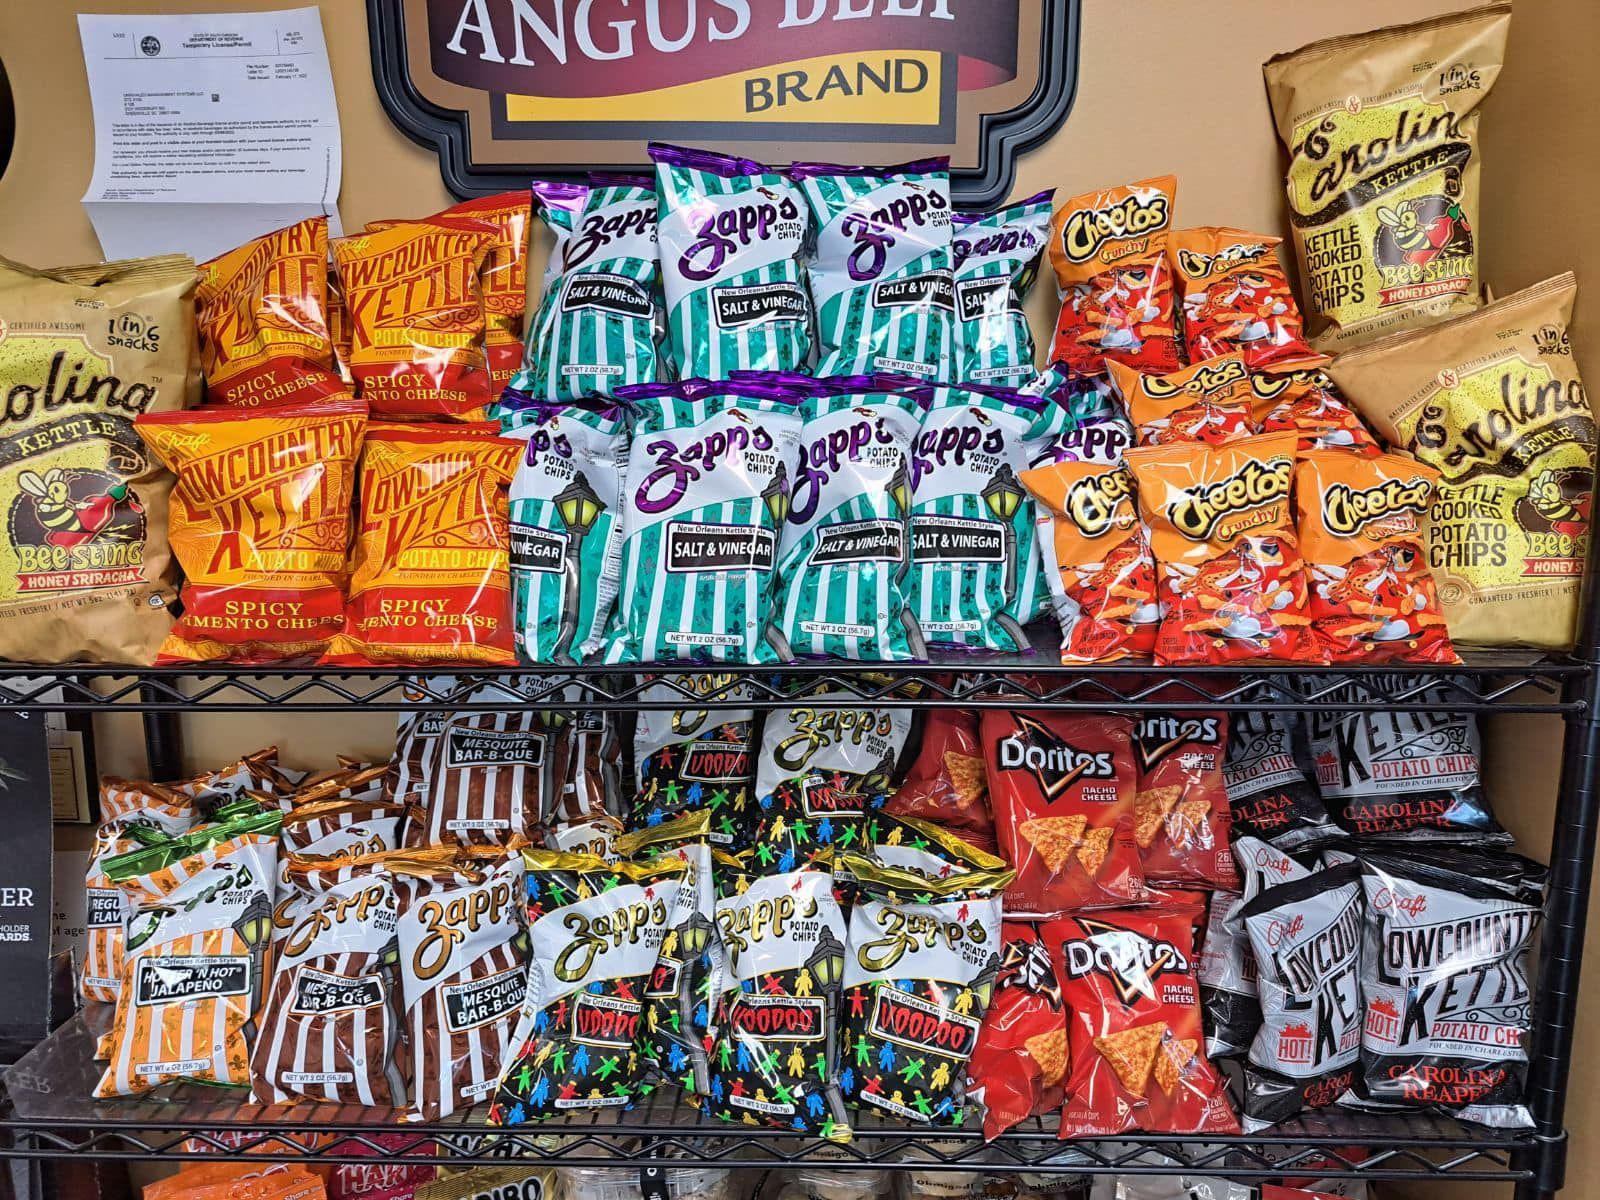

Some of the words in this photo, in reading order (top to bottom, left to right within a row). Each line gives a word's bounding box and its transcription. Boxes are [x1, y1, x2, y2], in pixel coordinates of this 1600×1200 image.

[447, 0, 752, 66] ANGUS
[745, 58, 929, 113] BRAND
[1439, 80, 1481, 95] snacks
[1371, 151, 1449, 194] KETTLE
[774, 222, 801, 233] POTATO
[777, 231, 801, 240] CHIPS
[841, 189, 947, 282] Zapp's
[1062, 195, 1169, 263] Cheetos
[677, 196, 799, 282] Zapp's
[1304, 225, 1360, 256] KETTLE
[1099, 238, 1148, 264] Crunchy
[1306, 243, 1362, 273] COOKED
[1308, 264, 1364, 291] POTATO
[568, 286, 592, 300] SALT
[591, 286, 601, 297] &
[601, 286, 649, 306] VINEGAR
[879, 282, 906, 297] SALT
[908, 282, 918, 294] &
[1312, 281, 1365, 314] CHIPS
[350, 257, 475, 349] KETTLE
[722, 301, 750, 316] SALT
[751, 299, 761, 312] &
[762, 296, 803, 312] VINEGAR
[49, 320, 87, 331] AWESOME
[123, 316, 140, 333] in
[146, 325, 160, 341] 6
[107, 335, 160, 353] snacks
[374, 330, 430, 347] POTATO
[434, 333, 470, 348] CHIP
[1537, 344, 1570, 356] snacks
[227, 370, 278, 403] SPICY
[264, 371, 328, 402] CHEESE
[364, 374, 425, 389] SPICY
[405, 388, 467, 402] CHEESE
[17, 418, 116, 456] KETTLE
[1512, 426, 1576, 466] KETTLE
[744, 451, 776, 465] POTATO
[867, 447, 899, 458] POTATO
[968, 452, 1000, 466] POTATO
[176, 417, 365, 522] LOWCOUNTRY
[543, 454, 574, 472] POTATO
[634, 425, 774, 514] Zapp's
[747, 462, 774, 476] CHIPS
[787, 417, 894, 526] Zapp's
[970, 463, 994, 475] CHIPS
[544, 466, 571, 481] CHIPS
[1166, 457, 1291, 541] Cheetos
[1434, 484, 1506, 506] KETTLE
[1323, 478, 1433, 538] Cheetos
[1430, 501, 1503, 522] COOKED
[677, 524, 694, 533] New
[696, 525, 723, 535] Orleans
[724, 526, 747, 535] Kettle
[925, 518, 954, 527] Orleans
[1216, 505, 1279, 542] Crunchy
[912, 533, 939, 548] SALT
[940, 533, 951, 547] &
[951, 533, 1000, 548] VINEGAR
[1430, 523, 1507, 545] POTATO
[511, 540, 560, 559] VINEGAR
[675, 543, 706, 558] SALT
[706, 542, 716, 556] &
[718, 542, 771, 557] VINEGAR
[818, 539, 844, 554] SALT
[845, 539, 855, 551] &
[856, 536, 900, 549] VINEGAR
[245, 549, 308, 572] POTATO
[313, 551, 344, 572] CHIPS
[399, 550, 460, 569] POTATO
[466, 550, 510, 569] CHIPS
[1430, 543, 1507, 569] CHIPS
[1533, 561, 1574, 573] HONEY
[28, 575, 70, 589] HONEY
[72, 572, 137, 588] SRIRACHA
[380, 599, 450, 613] SPICY
[1468, 592, 1514, 605] GUARANTEED
[225, 600, 304, 616] SPICY
[423, 615, 498, 630] CHEESE
[848, 626, 870, 636] (56.7g)
[670, 634, 684, 642] NET
[685, 634, 697, 643] WT
[704, 636, 714, 644] OZ
[715, 635, 739, 646] (56.7g)
[462, 738, 530, 750] MESQUITE
[773, 707, 892, 771] Zapp's
[866, 734, 888, 750] POTATO
[455, 749, 534, 762] BAR-B-QUE
[866, 745, 884, 759] CHIPS
[1001, 736, 1113, 777] Doritos
[1317, 764, 1340, 784] HOT!
[1371, 758, 1432, 780] POTATO
[1435, 754, 1479, 774] CHIPS
[1081, 787, 1117, 795] NACHO
[1375, 781, 1410, 790] FOUNDED
[1411, 780, 1420, 788] IN
[1343, 799, 1456, 821] CAROLINA
[1356, 816, 1452, 834] REAPER
[1255, 847, 1293, 874] Craft
[222, 896, 248, 905] CHIPS
[1373, 887, 1427, 918] Craft
[64, 926, 86, 938] age
[373, 919, 396, 933] CHIPS
[789, 922, 819, 933] POTATO
[1267, 915, 1304, 946] Craft
[554, 897, 667, 983] Zapp's
[792, 932, 816, 943] CHIPS
[857, 905, 988, 972] Zapp's
[960, 940, 988, 959] POTATO
[962, 951, 984, 968] CHIPS
[209, 967, 234, 979] HOT
[151, 980, 223, 998] JALAPEÑO
[450, 986, 466, 995] New
[466, 979, 494, 991] Orleans
[461, 977, 521, 1008] MESQUITE
[1163, 985, 1193, 994] NACHO
[592, 997, 617, 1008] Orleans
[619, 1002, 641, 1012] Kettle
[1162, 994, 1195, 1004] CHEESE
[732, 1005, 816, 1033] VOODOO
[879, 1003, 967, 1049] VOODOO
[1366, 1009, 1399, 1039] HOT!
[1431, 1022, 1489, 1042] POTATO
[1278, 1037, 1313, 1059] HOT!
[140, 1065, 153, 1073] NET
[154, 1064, 165, 1072] WT
[171, 1063, 182, 1071] OZ
[1388, 1064, 1506, 1086] CAROLINA
[915, 1179, 974, 1191] Ohmigod!
